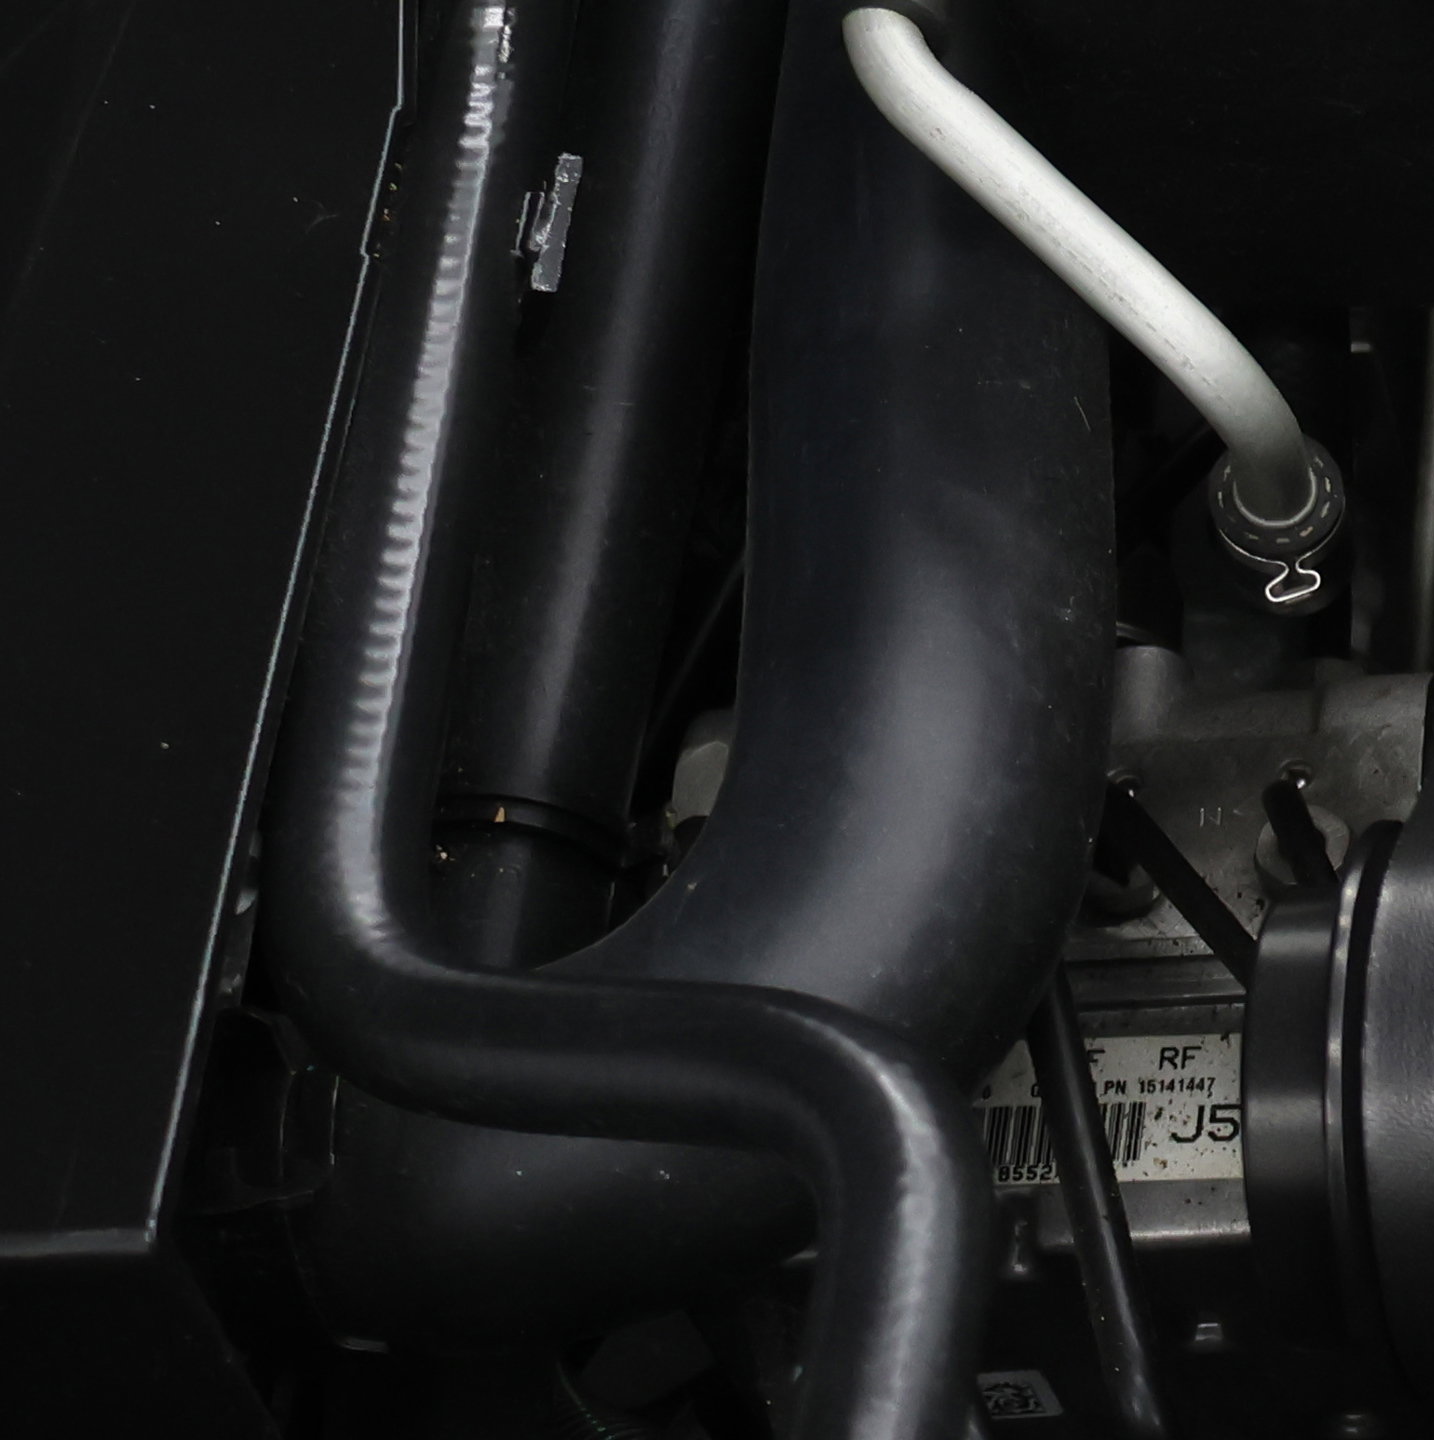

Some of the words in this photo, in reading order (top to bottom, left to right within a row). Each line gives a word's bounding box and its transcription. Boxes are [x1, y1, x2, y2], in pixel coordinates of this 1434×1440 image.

[1158, 1046, 1202, 1071] RF
[1103, 1079, 1127, 1095] PN
[1138, 1076, 1217, 1097] 15141447
[1170, 1104, 1242, 1143] J5
